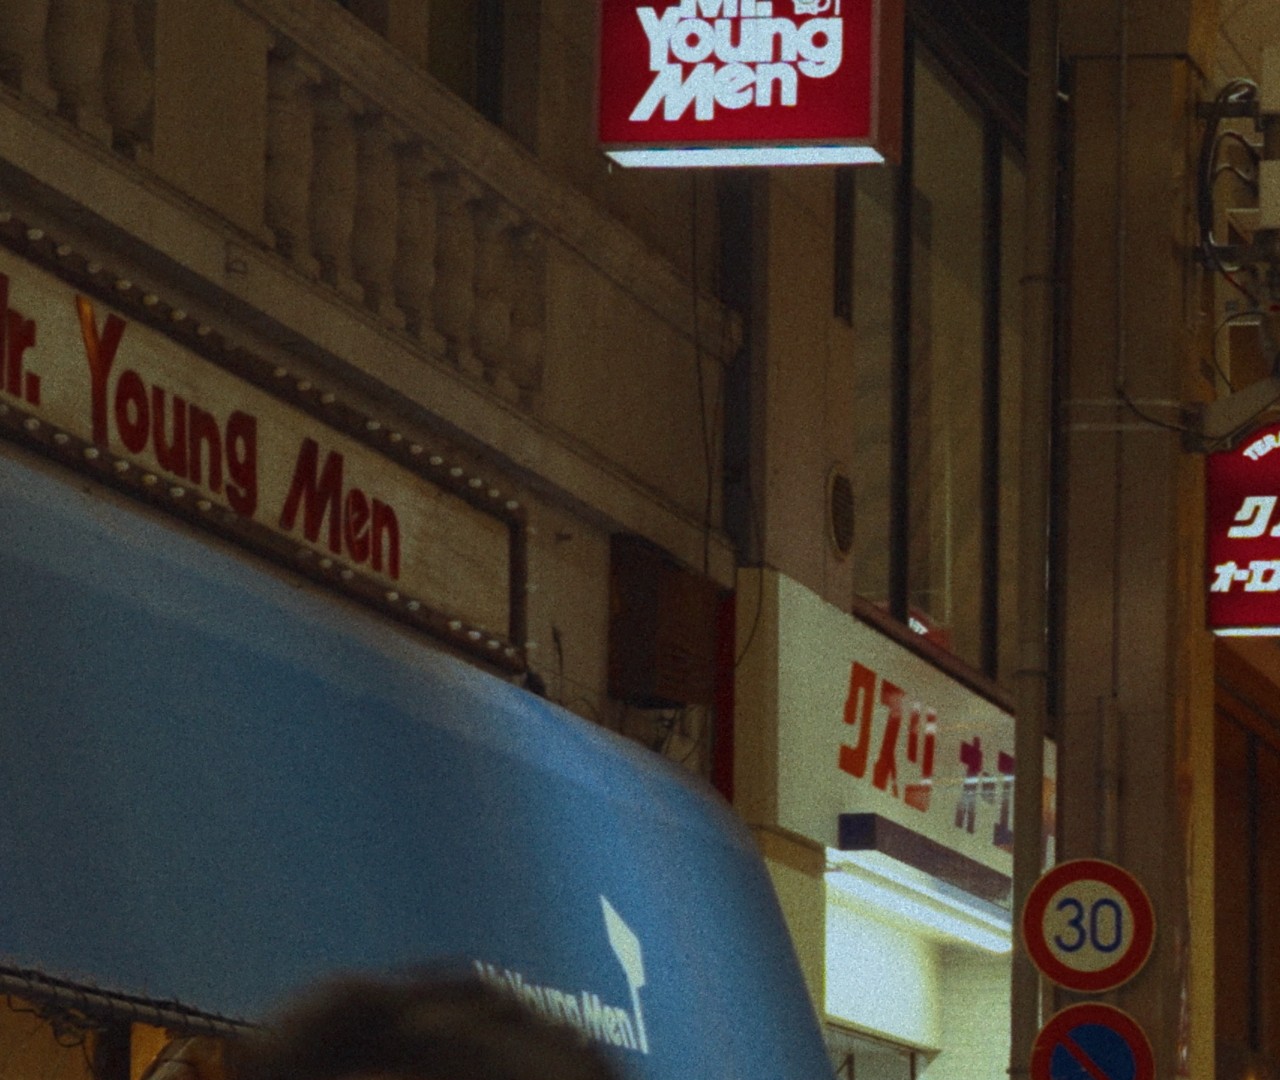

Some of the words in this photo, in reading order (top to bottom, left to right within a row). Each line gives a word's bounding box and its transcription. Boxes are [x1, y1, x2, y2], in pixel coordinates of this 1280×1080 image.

[636, 7, 843, 78] Young
[629, 62, 798, 121] Men
[0, 272, 41, 408] r.
[76, 293, 258, 520] Young
[279, 436, 400, 581] Men
[838, 660, 937, 813] クスリ
[1054, 897, 1123, 953] 30
